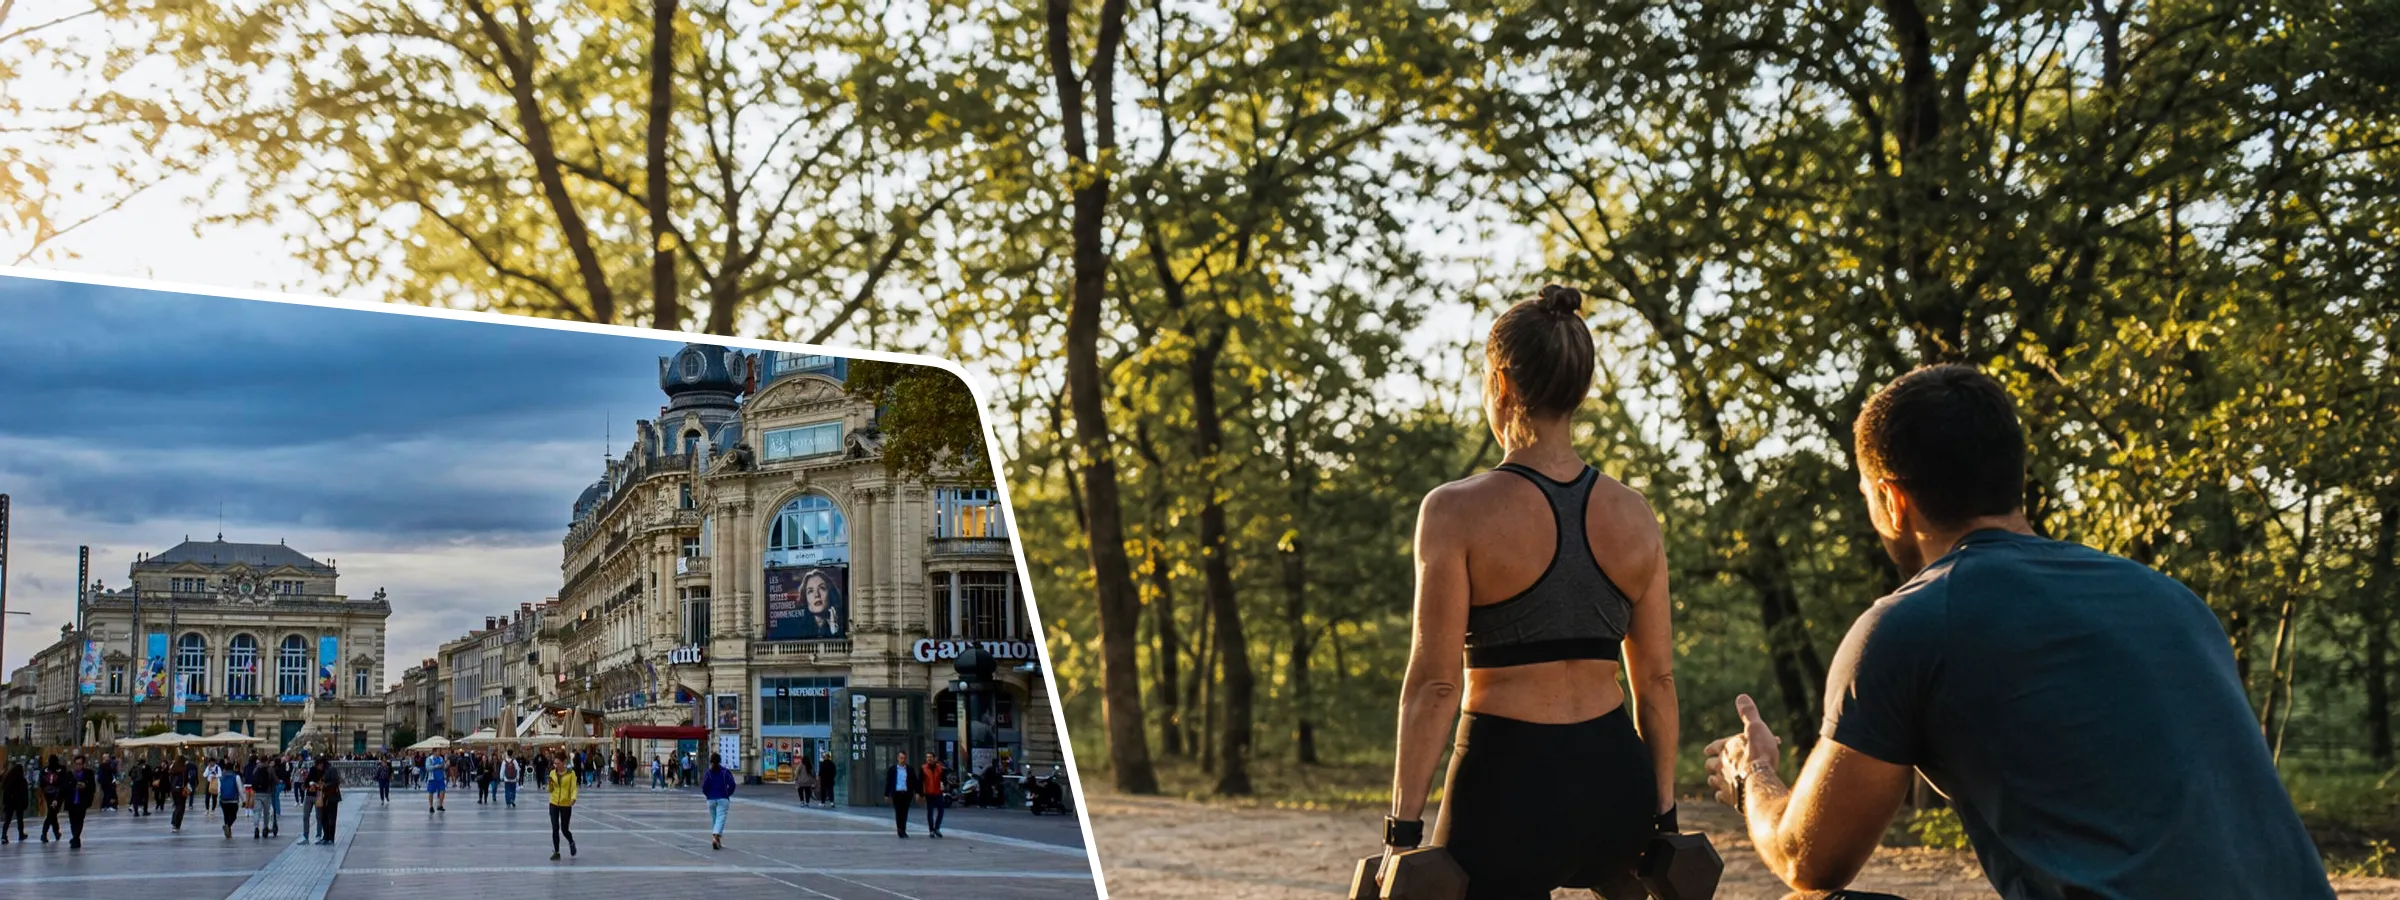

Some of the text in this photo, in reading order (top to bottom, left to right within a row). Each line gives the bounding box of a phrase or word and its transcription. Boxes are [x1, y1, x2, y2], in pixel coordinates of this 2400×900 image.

[769, 576, 779, 584] LES
[769, 584, 783, 593] PLUS
[769, 601, 796, 610] HISTOIRES
[769, 609, 805, 619] COMMENCENT
[852, 694, 867, 760] Parking
